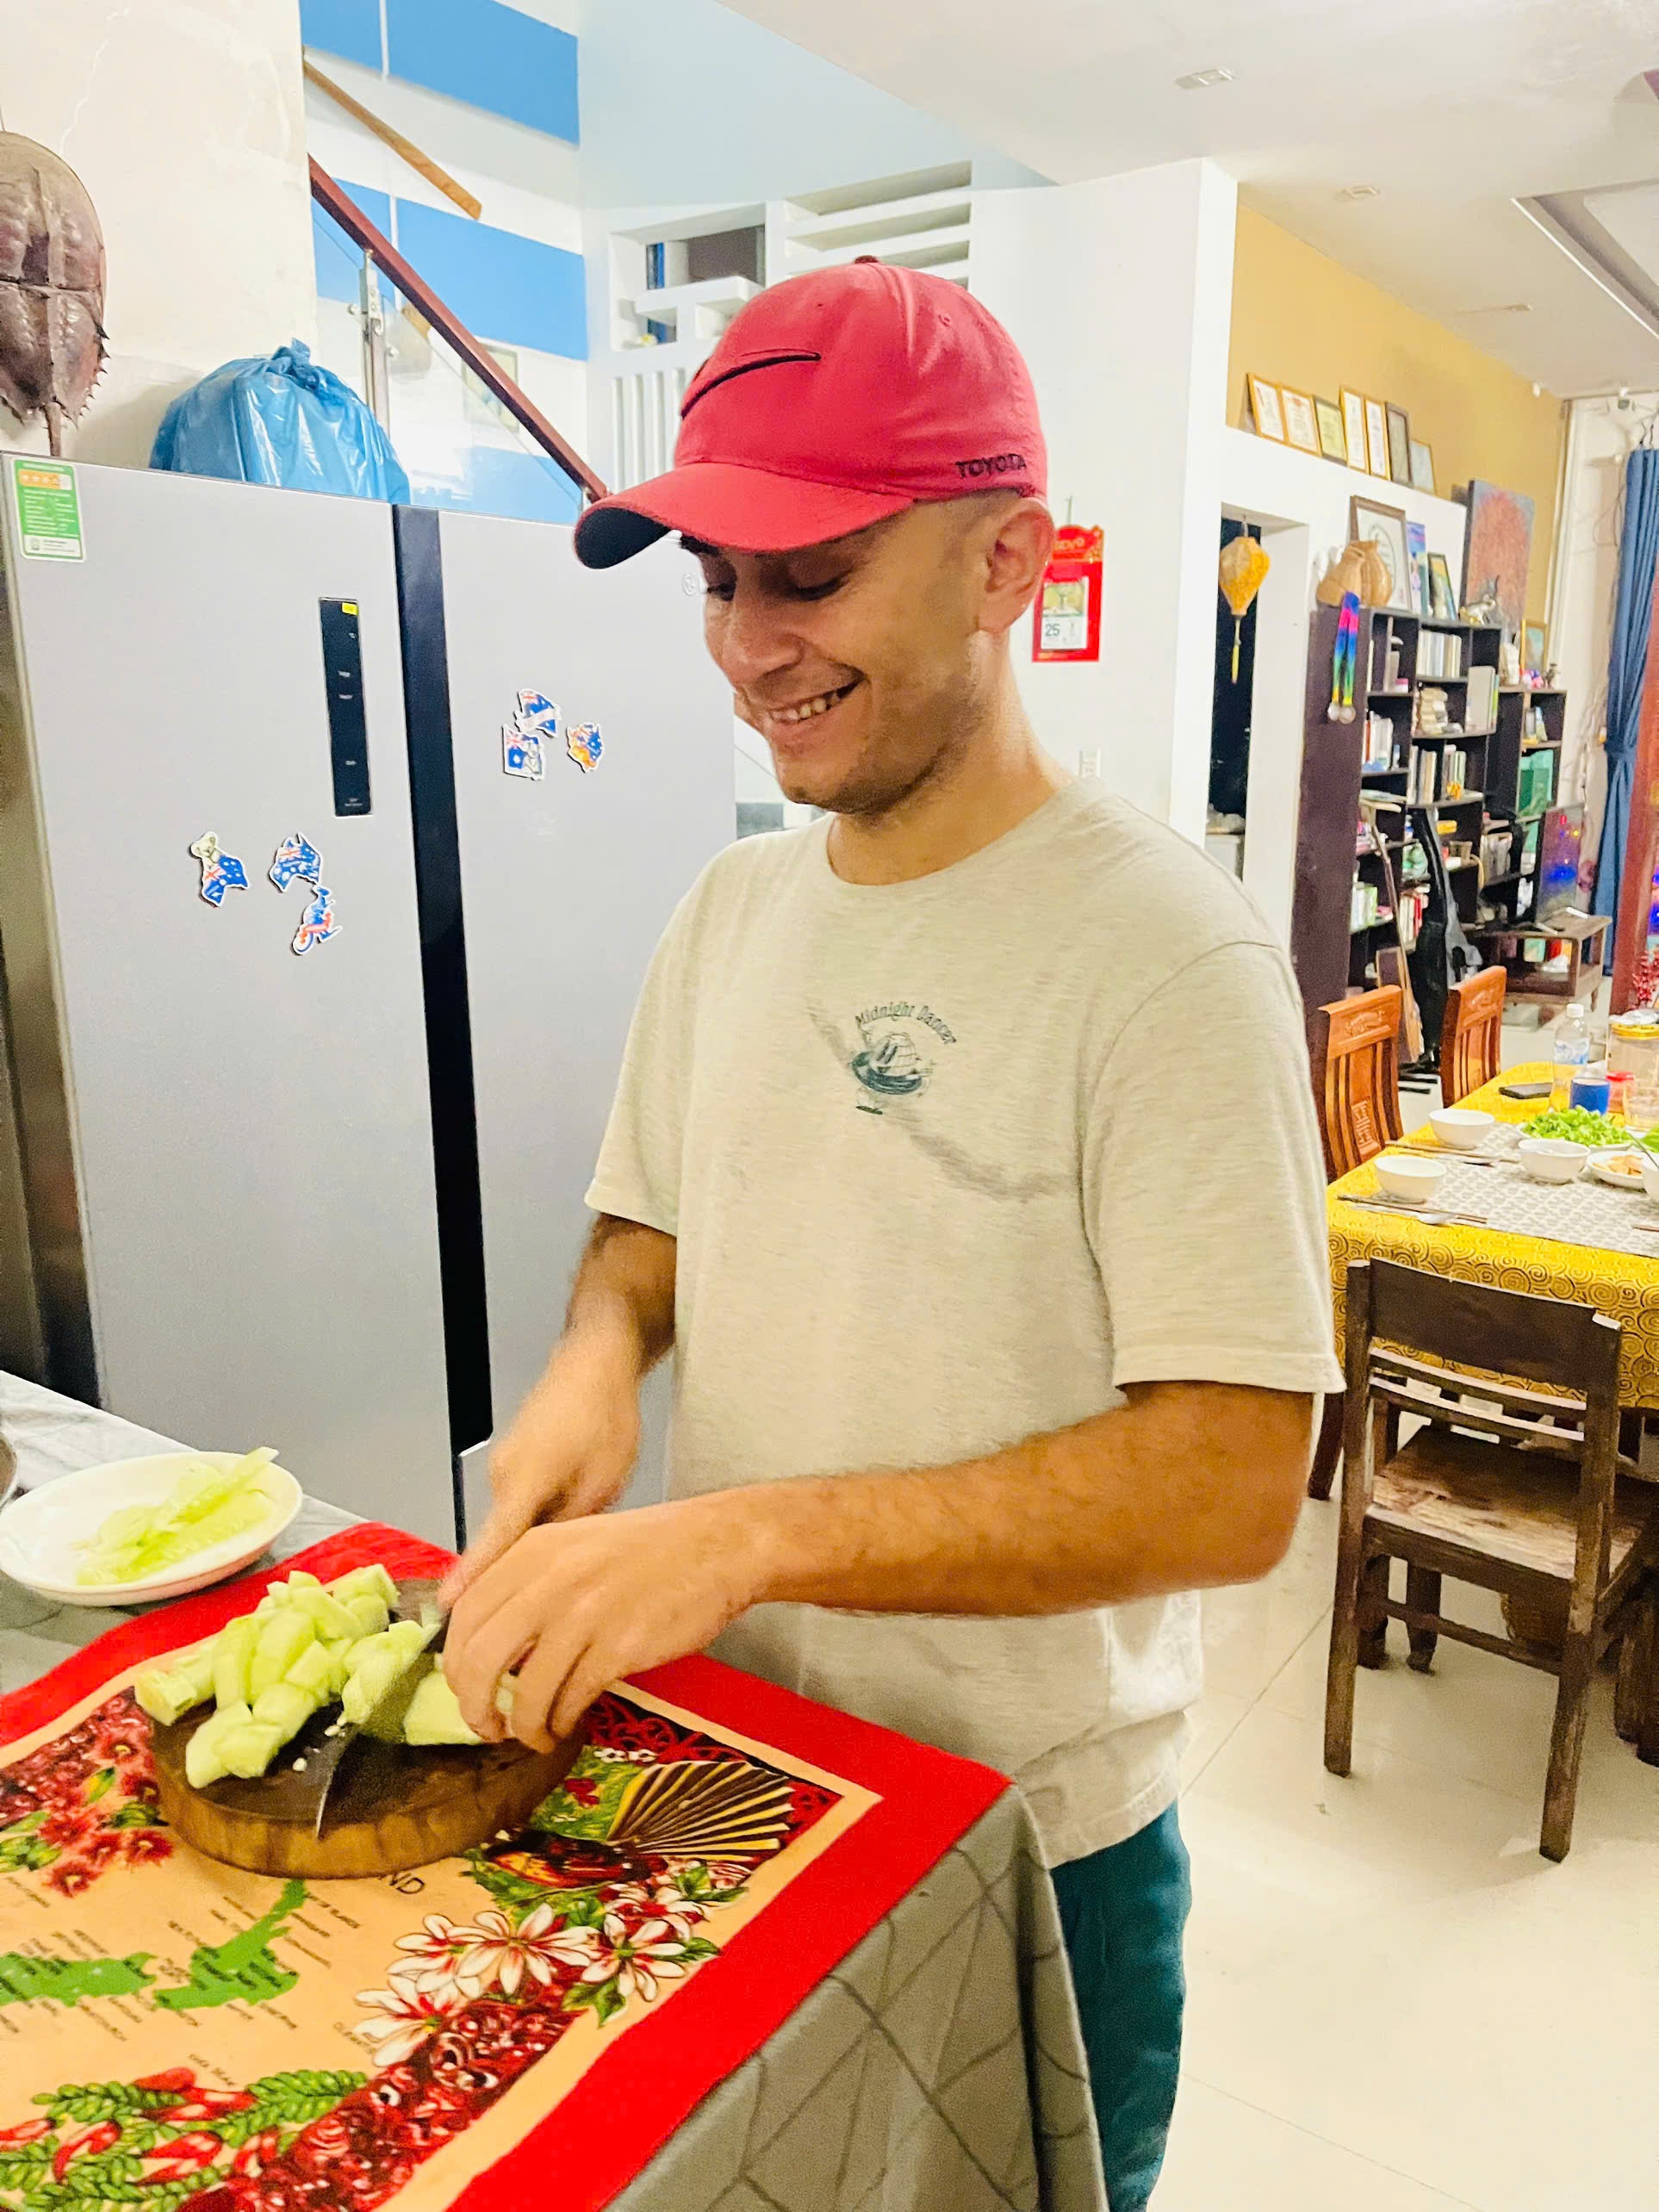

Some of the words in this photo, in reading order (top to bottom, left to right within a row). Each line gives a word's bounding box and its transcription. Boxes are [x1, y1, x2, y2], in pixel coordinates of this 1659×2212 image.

[955, 453, 1028, 479] TOYOTA
[1045, 623, 1060, 637] 25
[854, 1001, 915, 1026] Midnight
